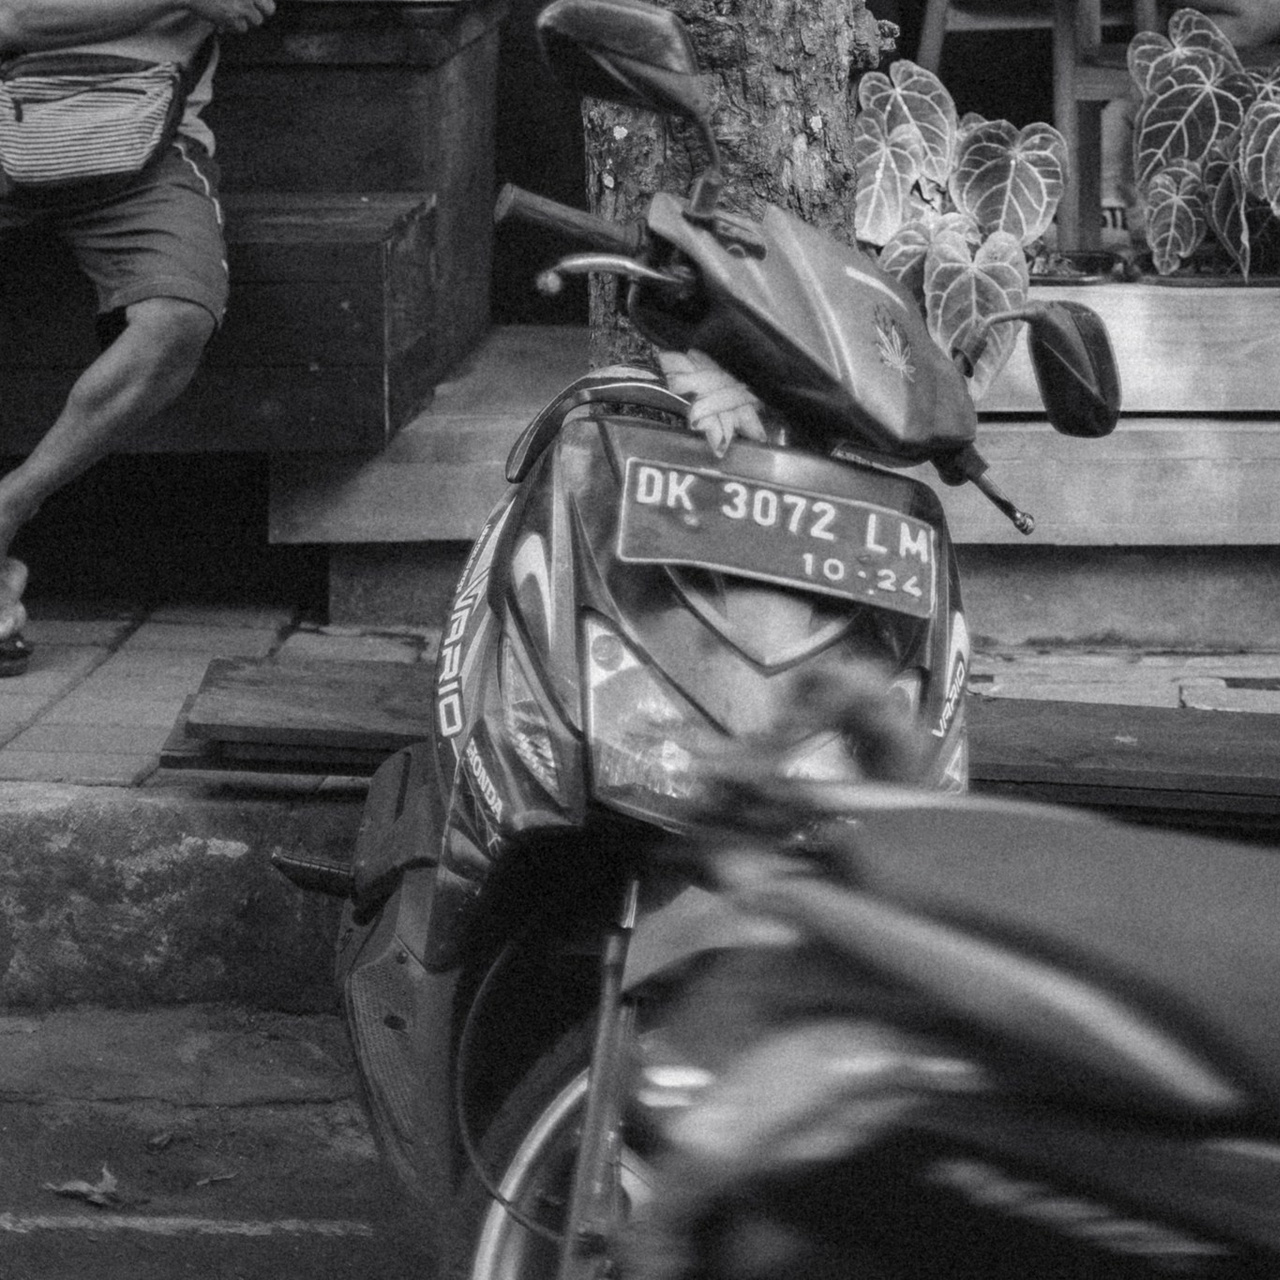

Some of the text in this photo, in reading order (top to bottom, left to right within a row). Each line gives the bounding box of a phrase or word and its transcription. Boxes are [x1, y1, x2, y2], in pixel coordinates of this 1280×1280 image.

[636, 466, 695, 510] DK
[721, 482, 837, 541] 3072
[438, 566, 490, 737] VARIO
[932, 660, 965, 737] VARIO
[466, 737, 503, 824] HONDA
